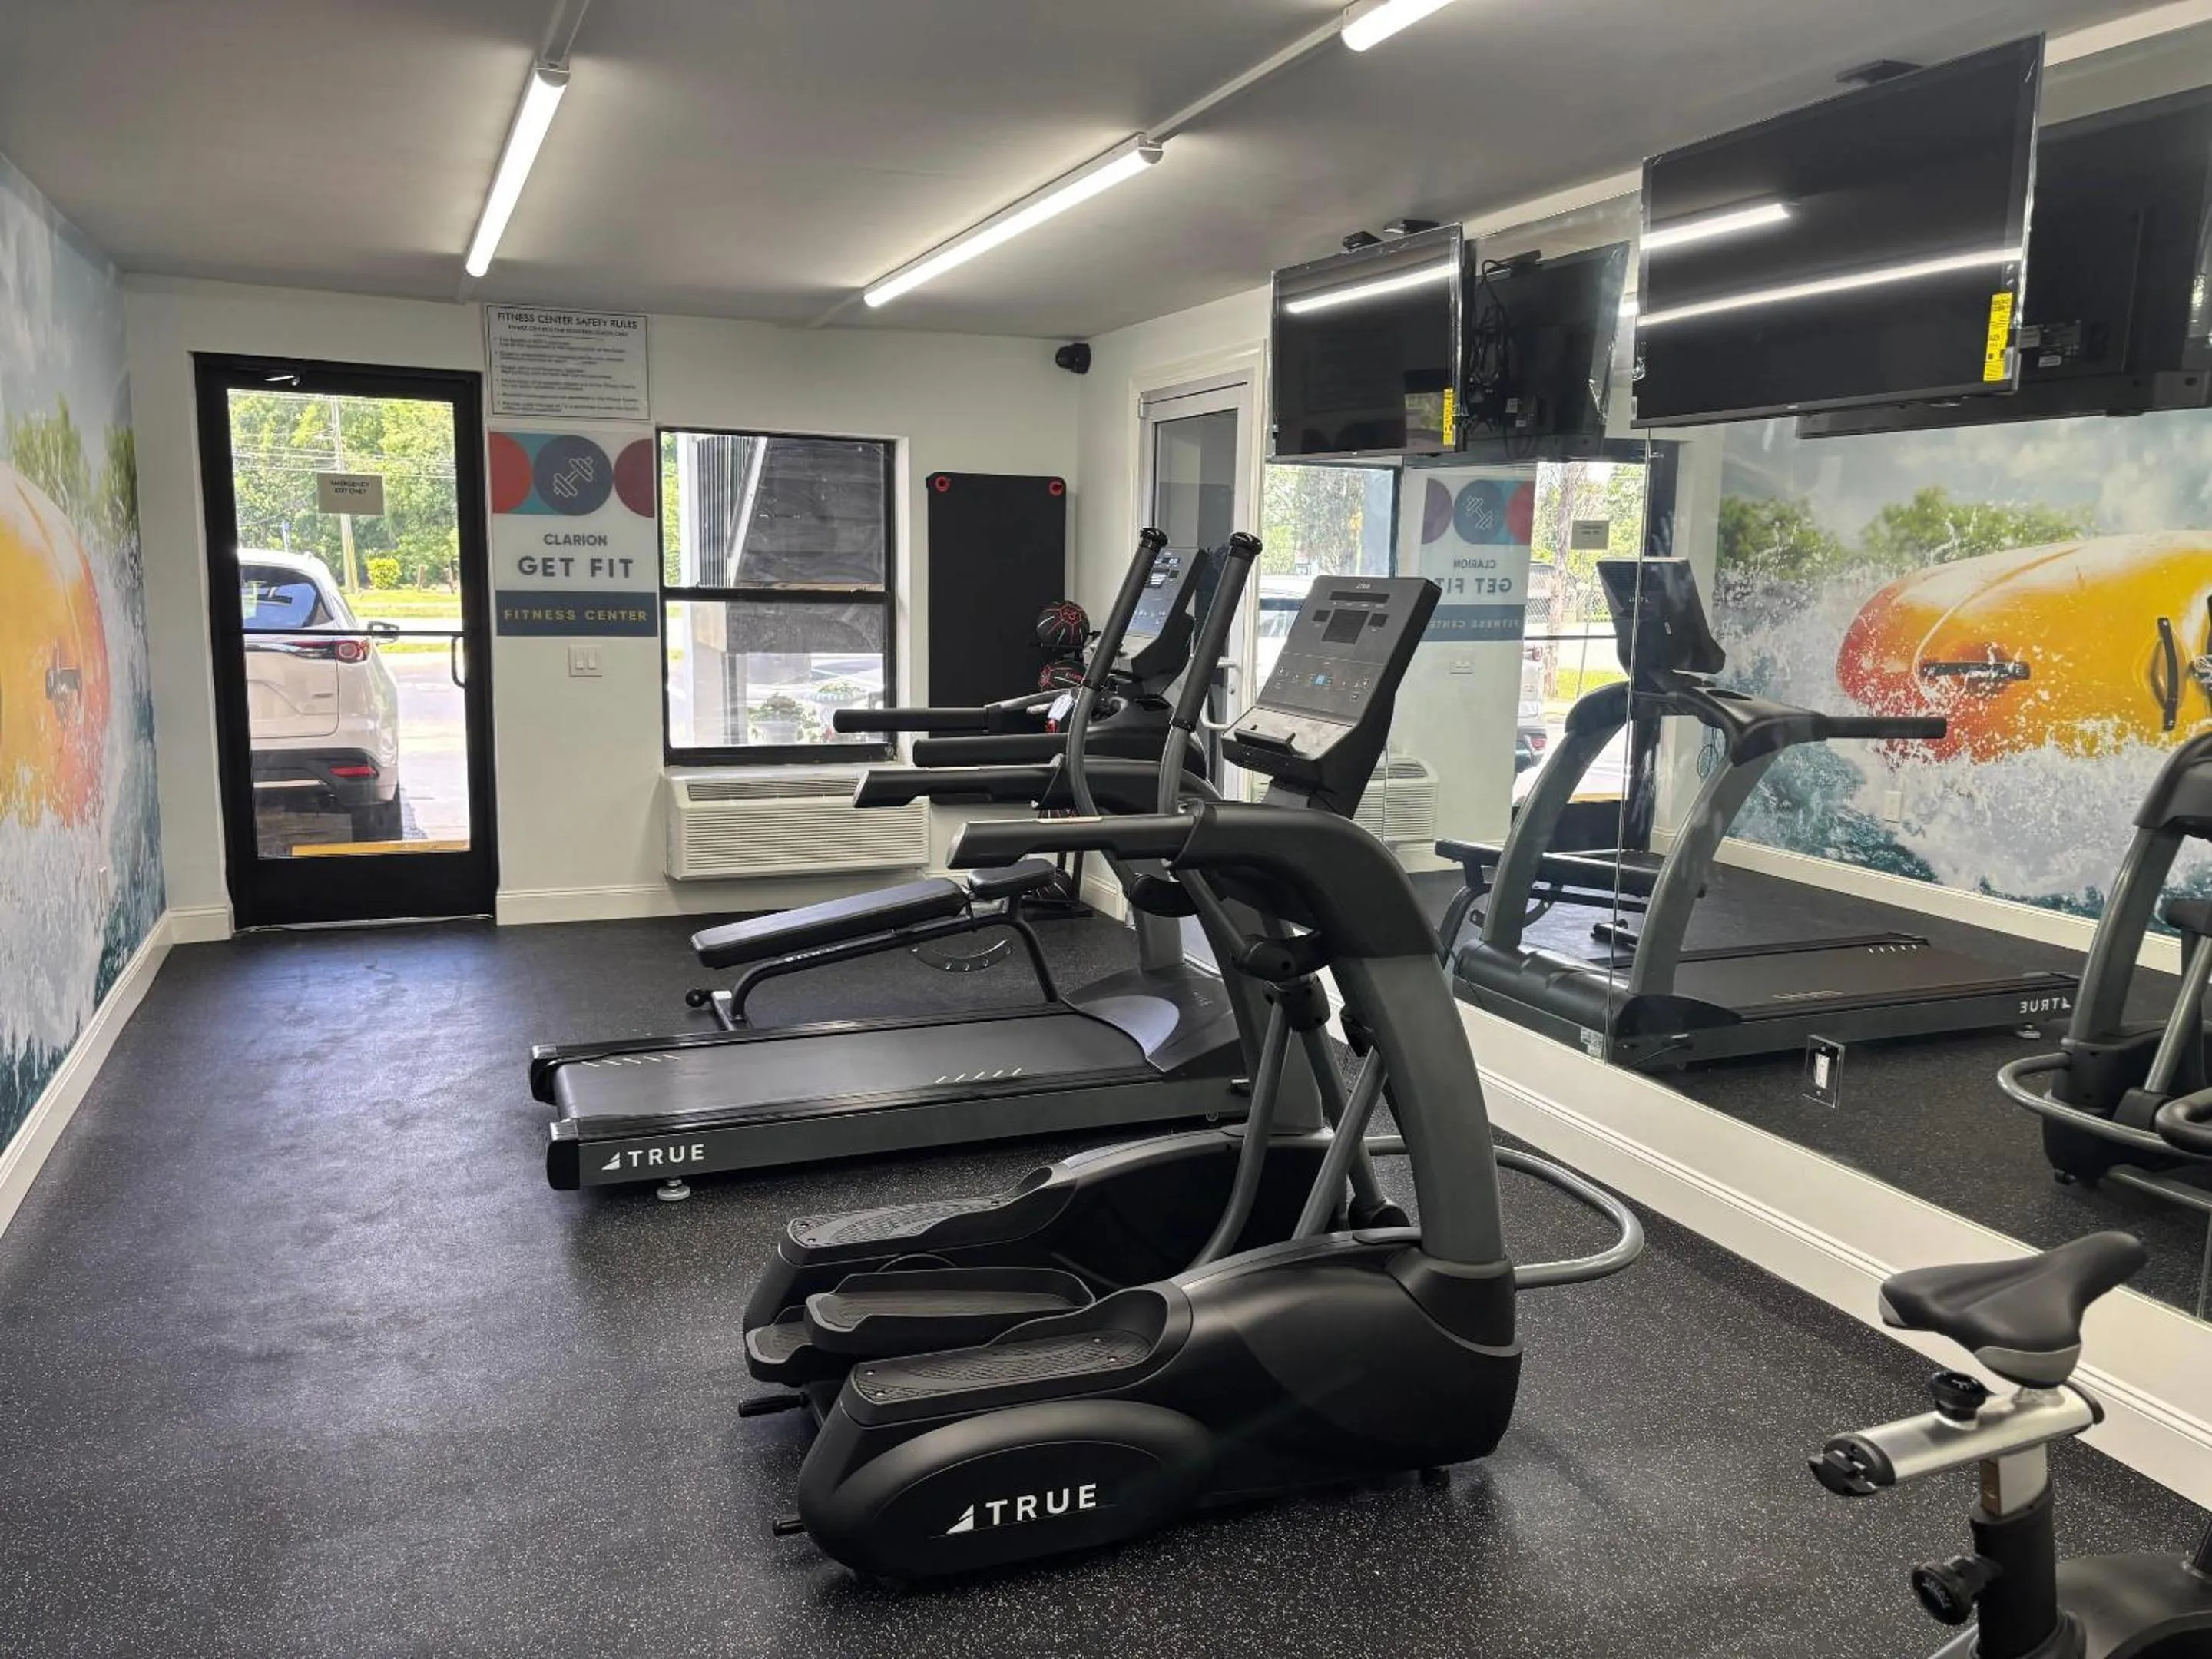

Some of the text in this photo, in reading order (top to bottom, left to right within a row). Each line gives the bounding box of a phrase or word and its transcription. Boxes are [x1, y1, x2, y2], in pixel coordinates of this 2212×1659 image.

[498, 312, 637, 329] FITNESS CENTER SAFETY RULES
[544, 534, 608, 546] CLARION
[518, 555, 634, 578] GET FIT
[504, 609, 647, 621] FITNESS CENTER
[628, 1144, 704, 1167] TRUE
[985, 1483, 1097, 1525] TRUE
